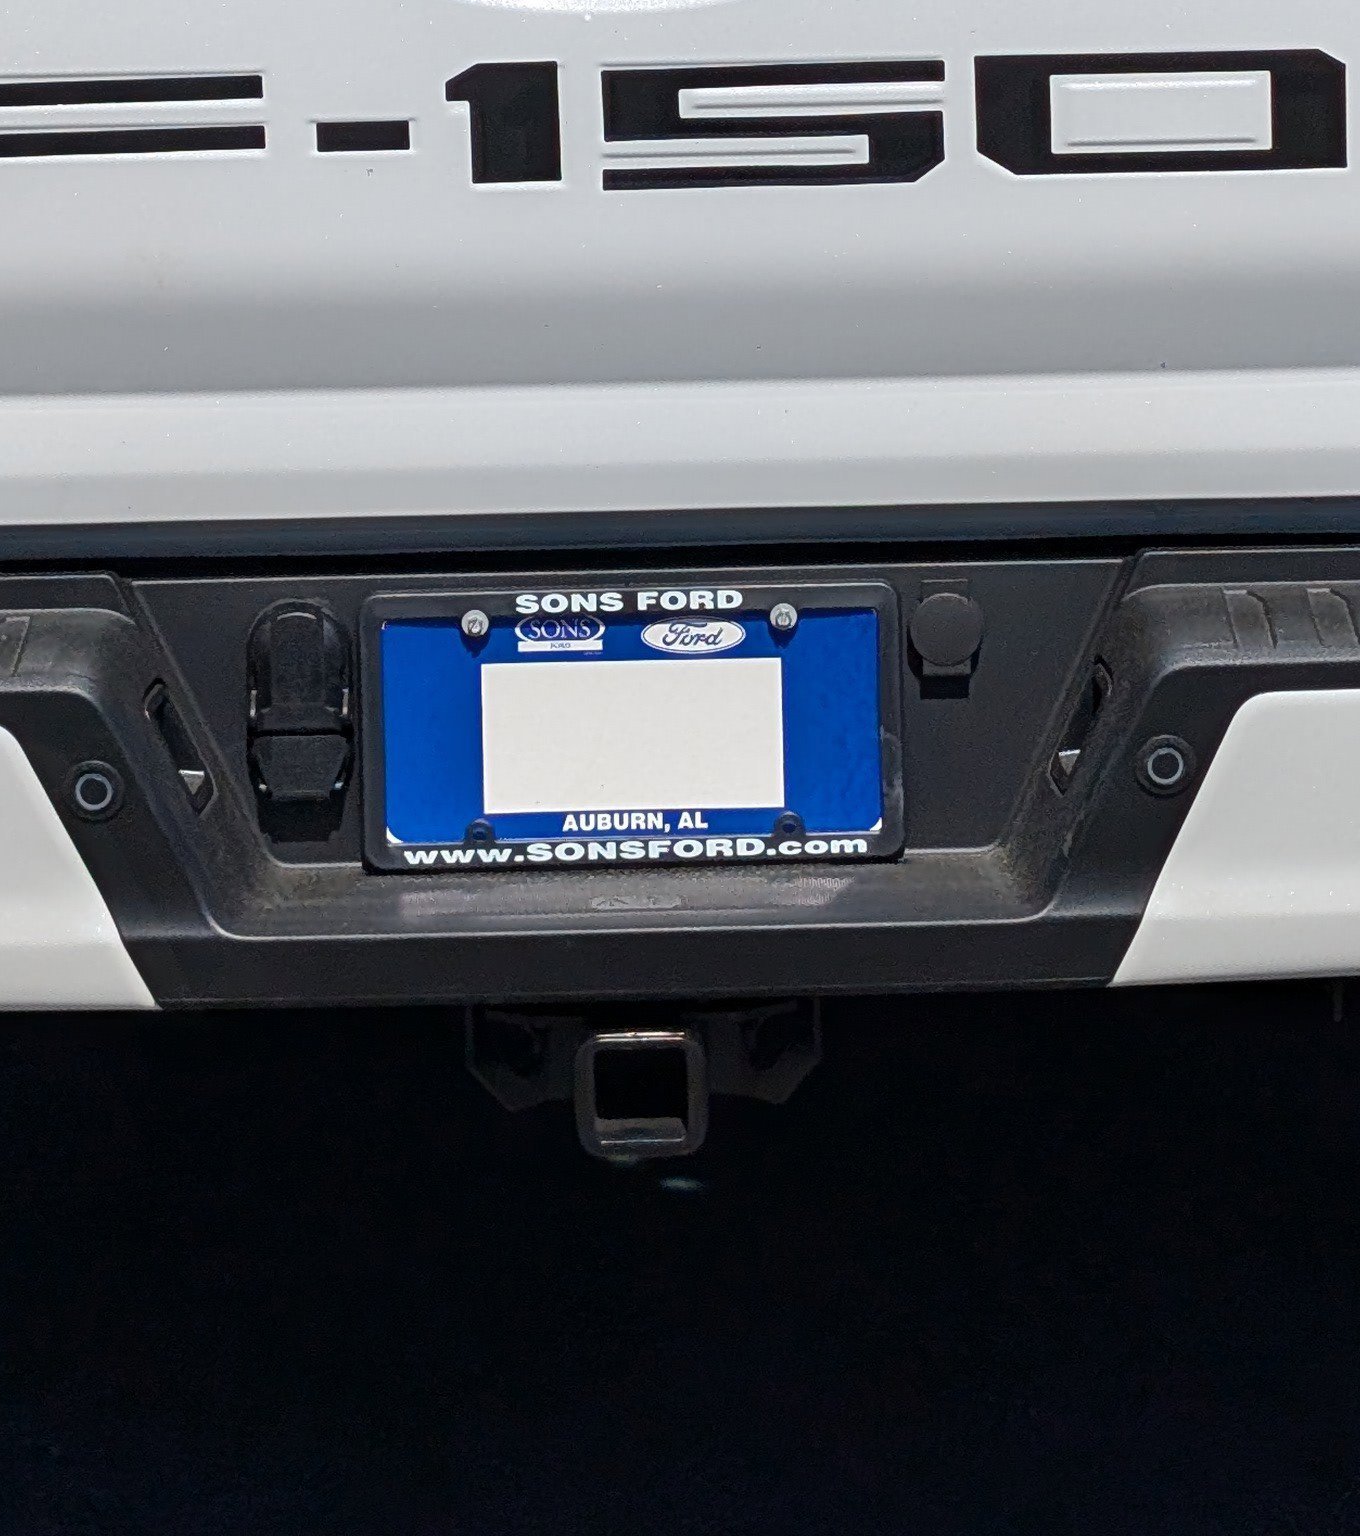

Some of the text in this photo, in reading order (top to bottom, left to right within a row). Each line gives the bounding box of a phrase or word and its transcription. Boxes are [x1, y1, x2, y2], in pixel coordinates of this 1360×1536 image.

[515, 590, 743, 614] SONS FORD
[528, 618, 591, 639] SONS
[662, 621, 723, 646] Ford
[562, 812, 708, 833] AUBURN, AL
[404, 838, 868, 865] www.SONSFORD.com
